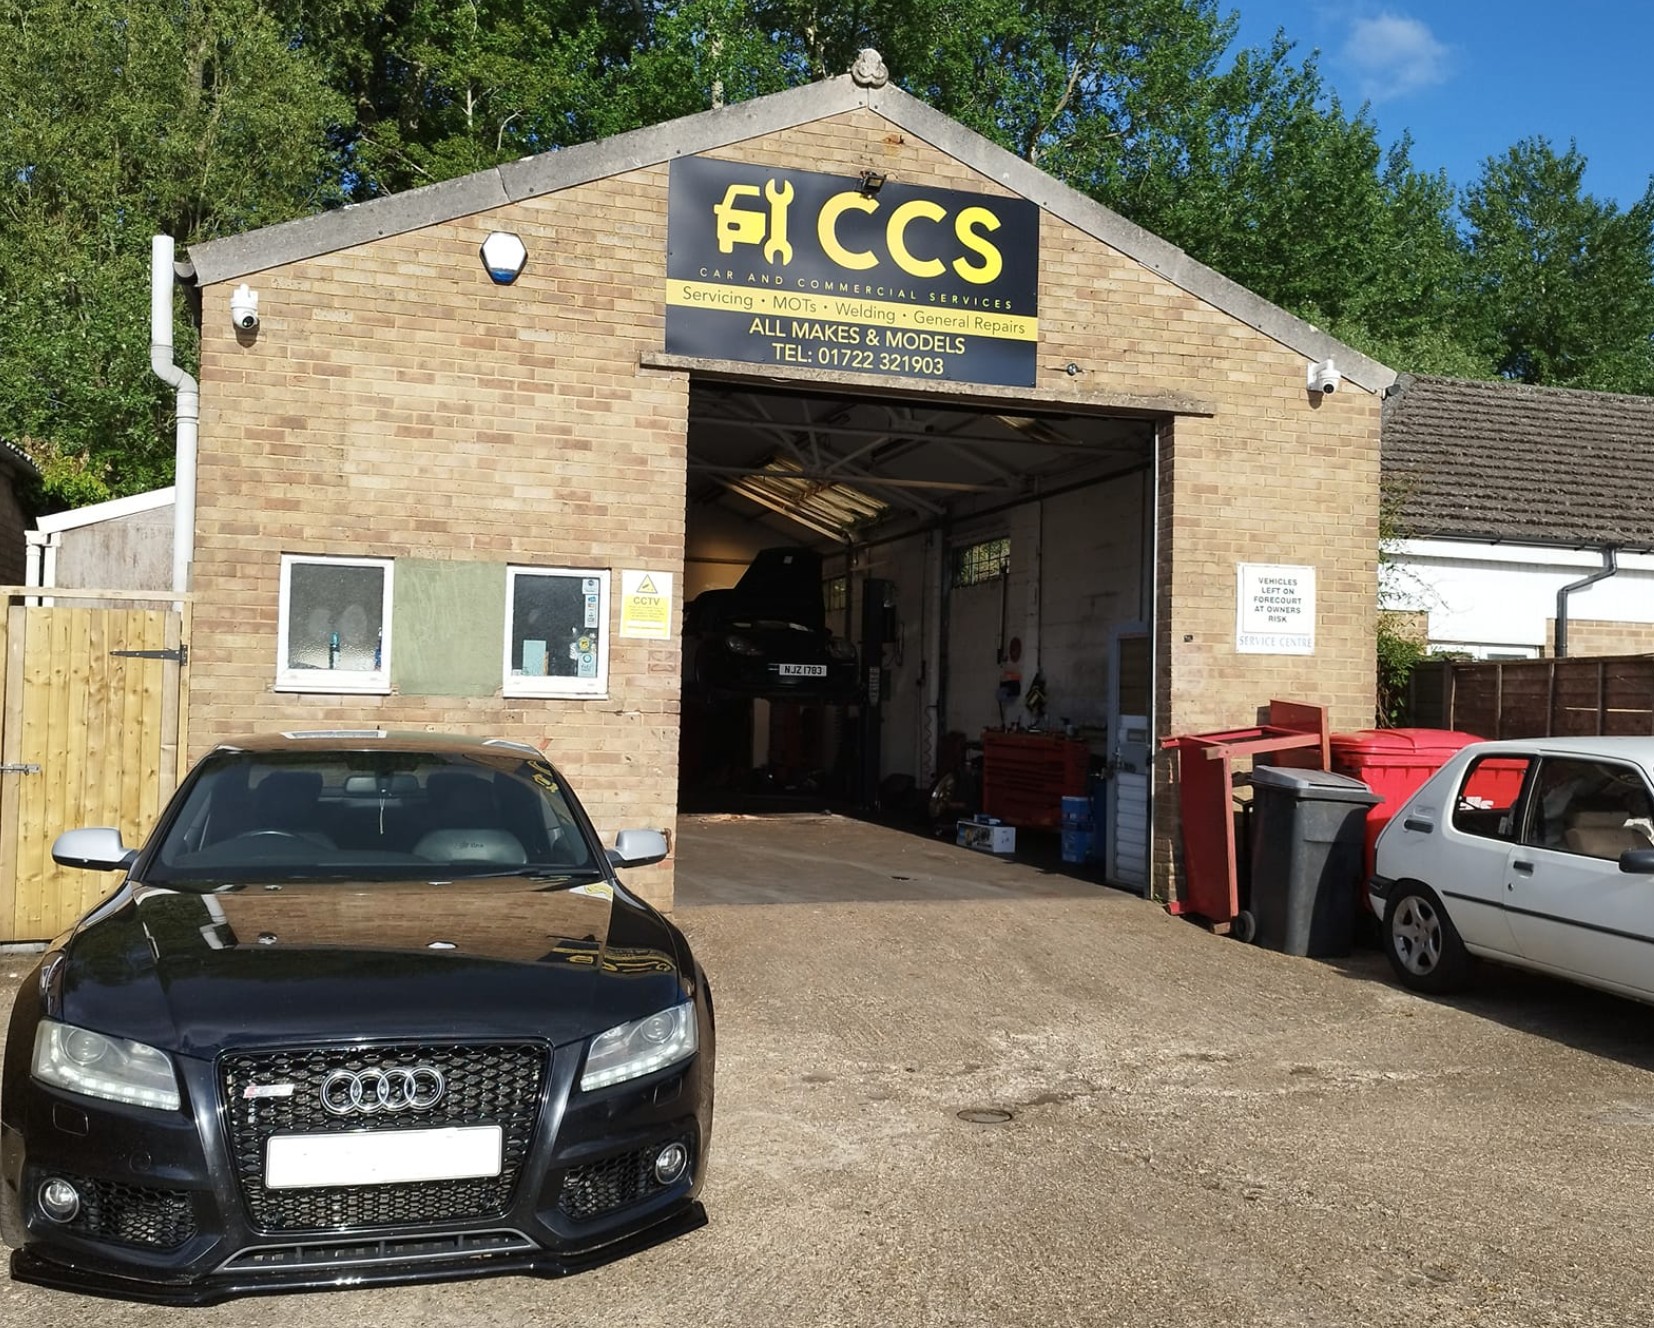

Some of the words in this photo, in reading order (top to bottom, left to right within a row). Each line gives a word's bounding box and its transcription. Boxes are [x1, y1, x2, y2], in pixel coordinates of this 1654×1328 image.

[817, 191, 1003, 284] CCS
[700, 267, 733, 280] CAR
[748, 273, 783, 285] AND
[797, 278, 917, 299] COMMERCIAL
[929, 292, 1012, 309] SERVICES
[683, 286, 753, 310] Servicing
[773, 295, 817, 313] MOTs
[835, 302, 895, 324] Welding
[914, 310, 970, 329] General
[975, 316, 1026, 335] Repairs
[749, 317, 786, 337] ALL
[791, 321, 860, 344] MAKES
[866, 328, 880, 346] &
[886, 330, 965, 354] MODELS
[772, 342, 813, 363] TEL:
[818, 347, 874, 368] 01722
[879, 352, 944, 375] 321903
[1258, 577, 1298, 586] VEHICLES
[633, 596, 660, 606] CCTV
[1253, 596, 1302, 605] FORECOURT
[1266, 606, 1301, 614] OWNERS
[1268, 615, 1287, 623] RISK
[1239, 635, 1275, 647] SERVICE
[1279, 636, 1312, 648] CENTRE
